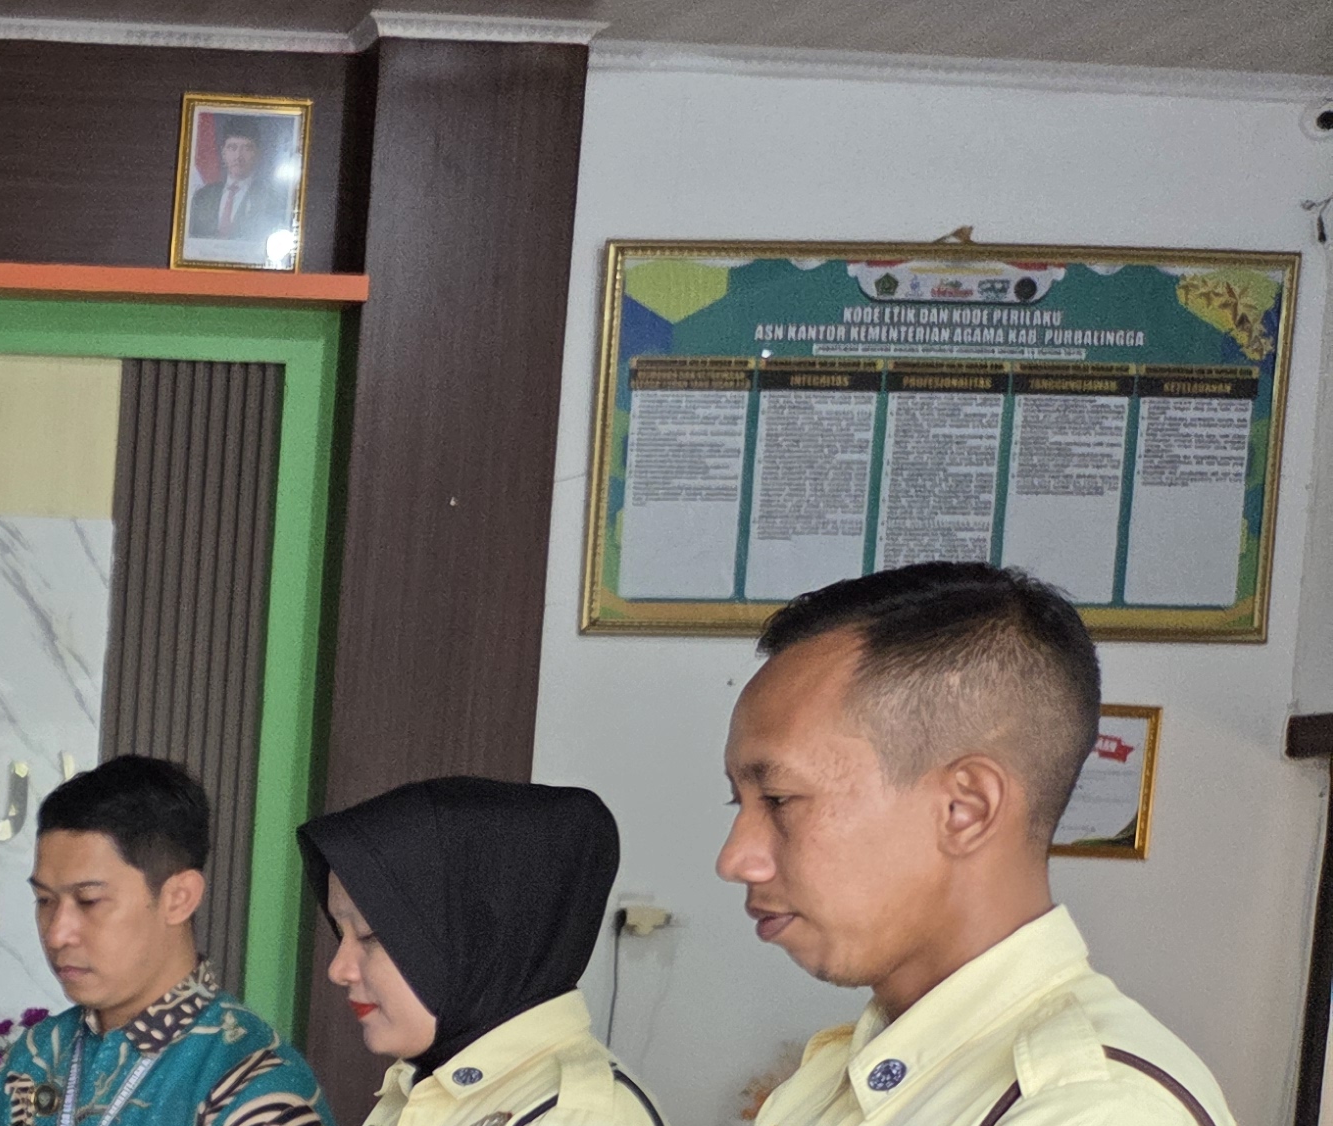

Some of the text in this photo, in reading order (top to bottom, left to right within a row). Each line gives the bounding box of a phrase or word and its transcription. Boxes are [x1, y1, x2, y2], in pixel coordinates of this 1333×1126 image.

[843, 307, 1062, 327] KODE ETIK DAN KODE PERILAKU
[755, 324, 783, 341] ASN
[787, 325, 846, 341] KANTOR
[850, 326, 951, 343] KEMENTERIAN
[953, 327, 1005, 344] AGAMA
[1044, 330, 1146, 347] PURBALINGGA
